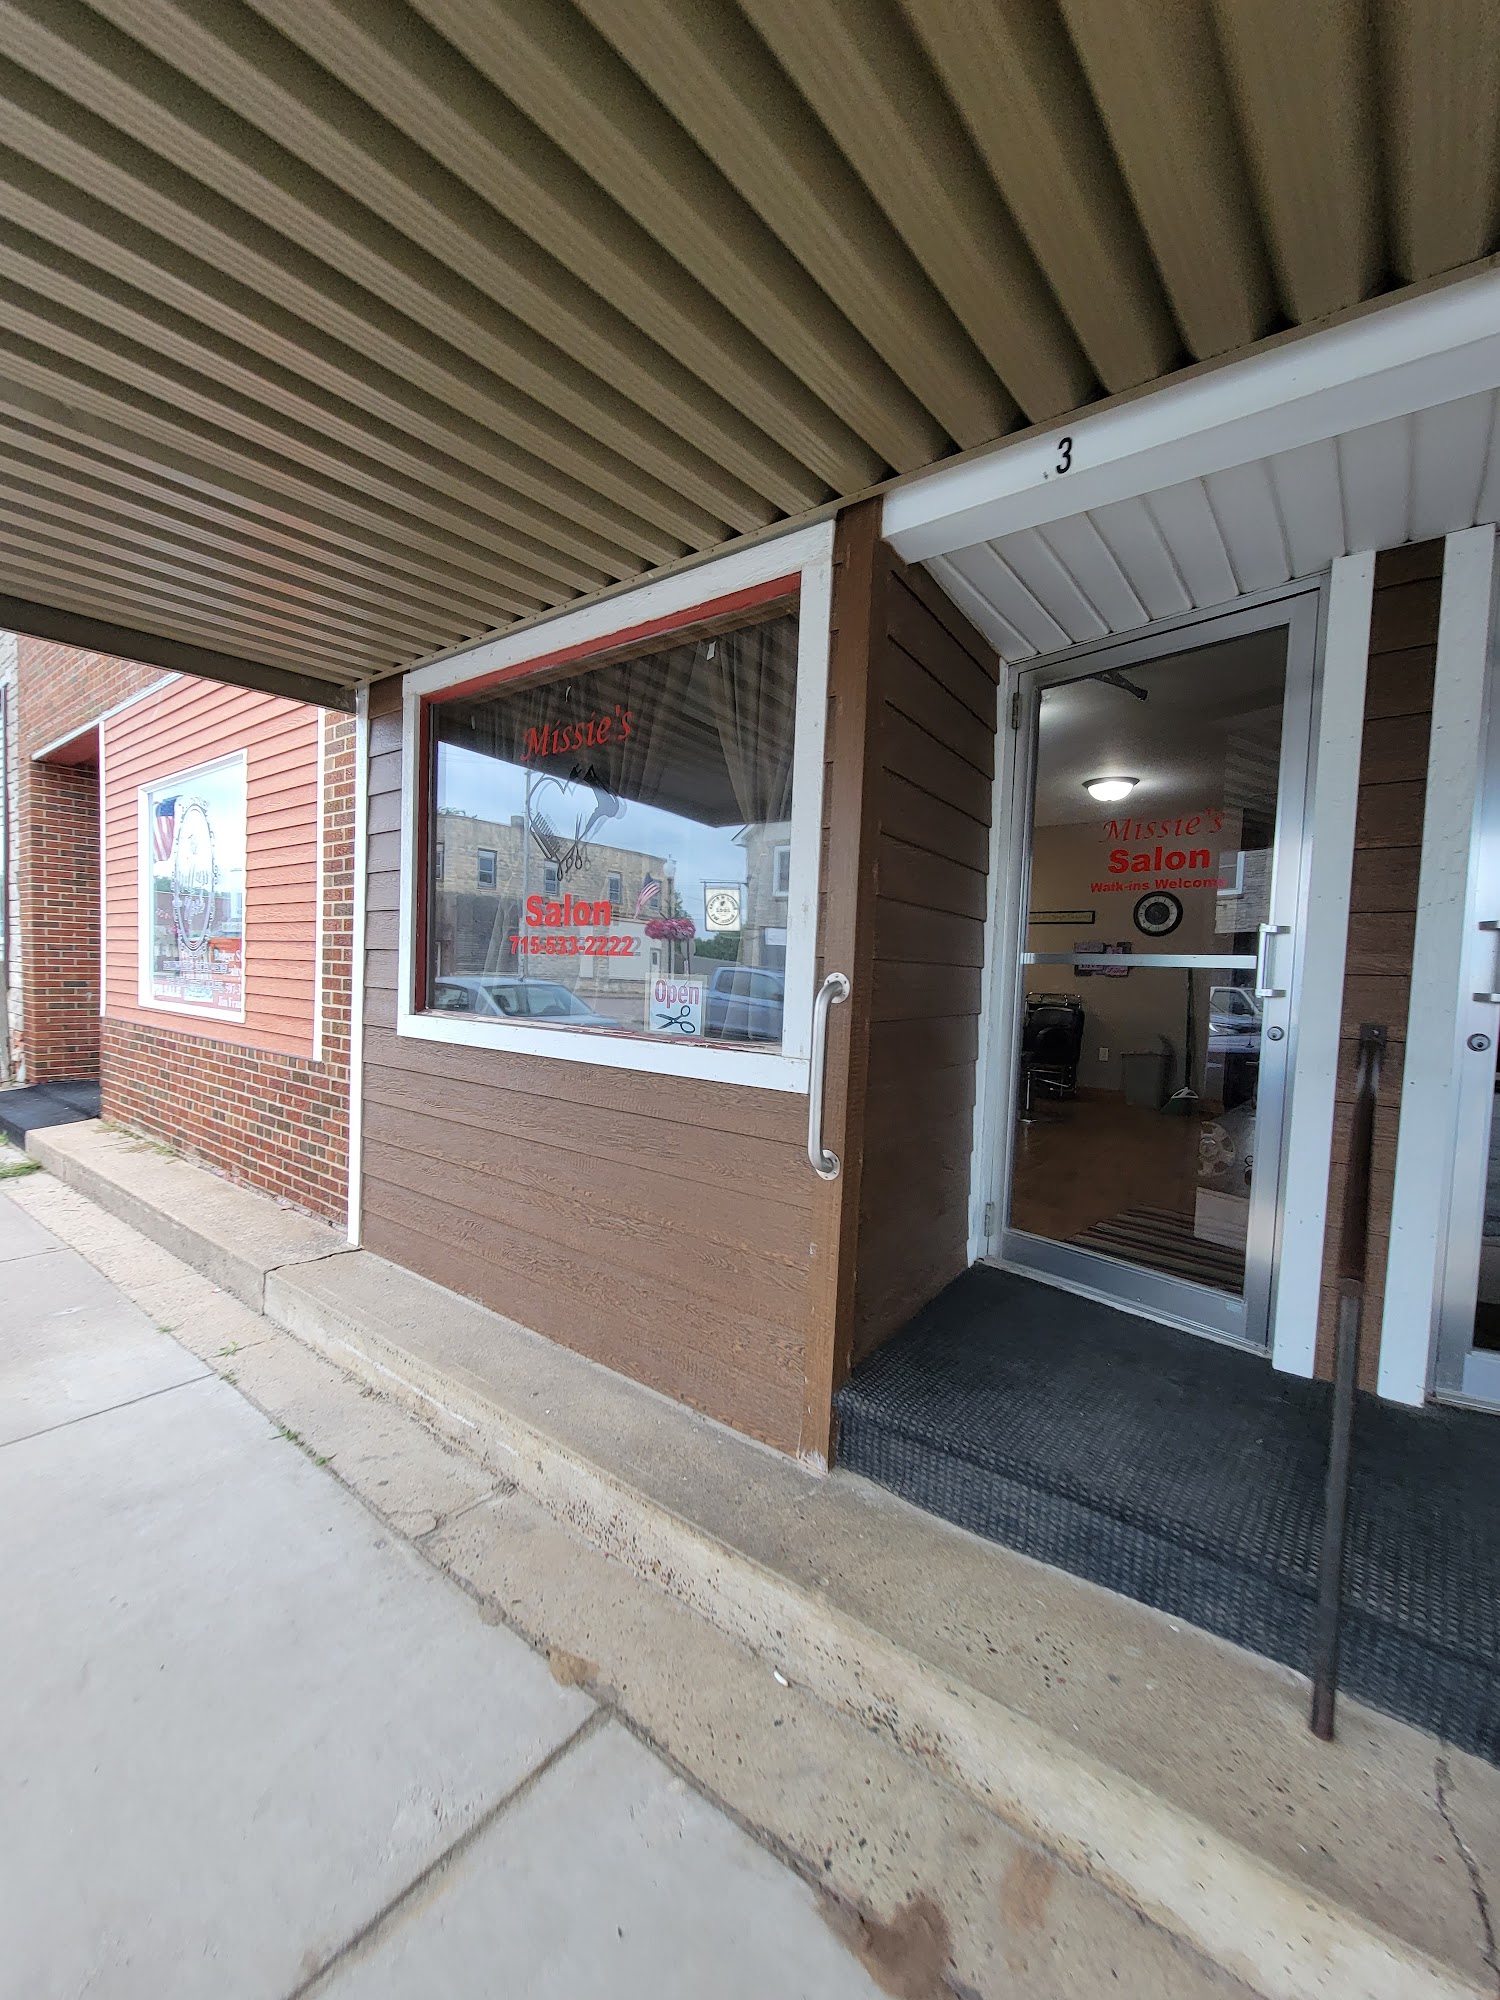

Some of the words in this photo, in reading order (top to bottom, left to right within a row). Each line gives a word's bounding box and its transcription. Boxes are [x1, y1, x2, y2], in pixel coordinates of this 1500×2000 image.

[1056, 437, 1072, 474] 3
[520, 704, 633, 761] Missie's
[1099, 807, 1225, 842] Missie's
[1108, 846, 1211, 874] Salon
[1090, 880, 1150, 893] Walk-ins
[1155, 877, 1229, 890] Welcome
[525, 893, 612, 927] Salon
[509, 935, 634, 957] 715-533-2222
[654, 979, 700, 1008] Open
